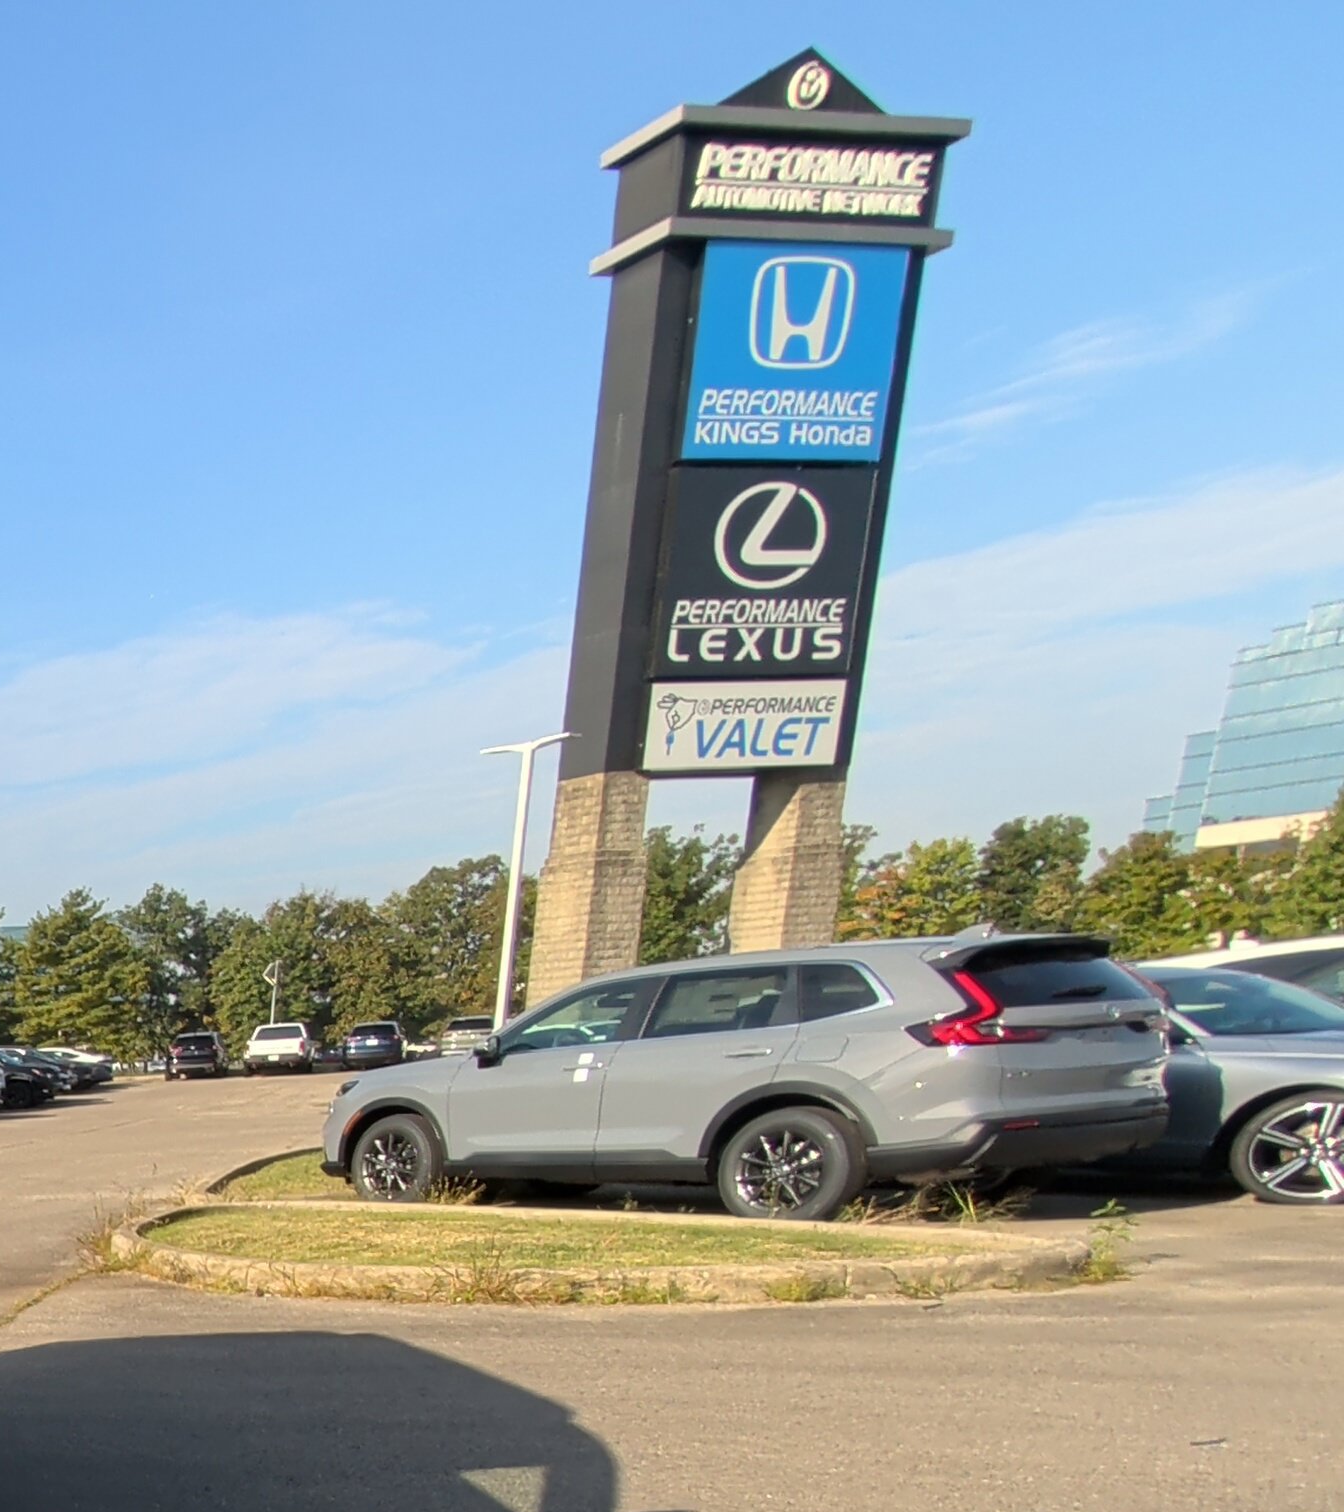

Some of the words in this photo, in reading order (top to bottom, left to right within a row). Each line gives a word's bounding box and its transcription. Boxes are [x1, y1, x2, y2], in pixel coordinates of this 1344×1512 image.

[697, 143, 934, 186] PERFORMANCE
[691, 185, 822, 212] AUTOMOTIVE
[822, 190, 924, 216] NETWORK
[698, 389, 878, 416] PERFORMANCE
[694, 421, 780, 444] KINGS
[789, 422, 871, 446] Honda
[671, 598, 847, 623] PERFORMANCE
[667, 628, 843, 662] LEXUS
[710, 696, 837, 715] PERFORMANCE
[696, 717, 831, 758] VALET
